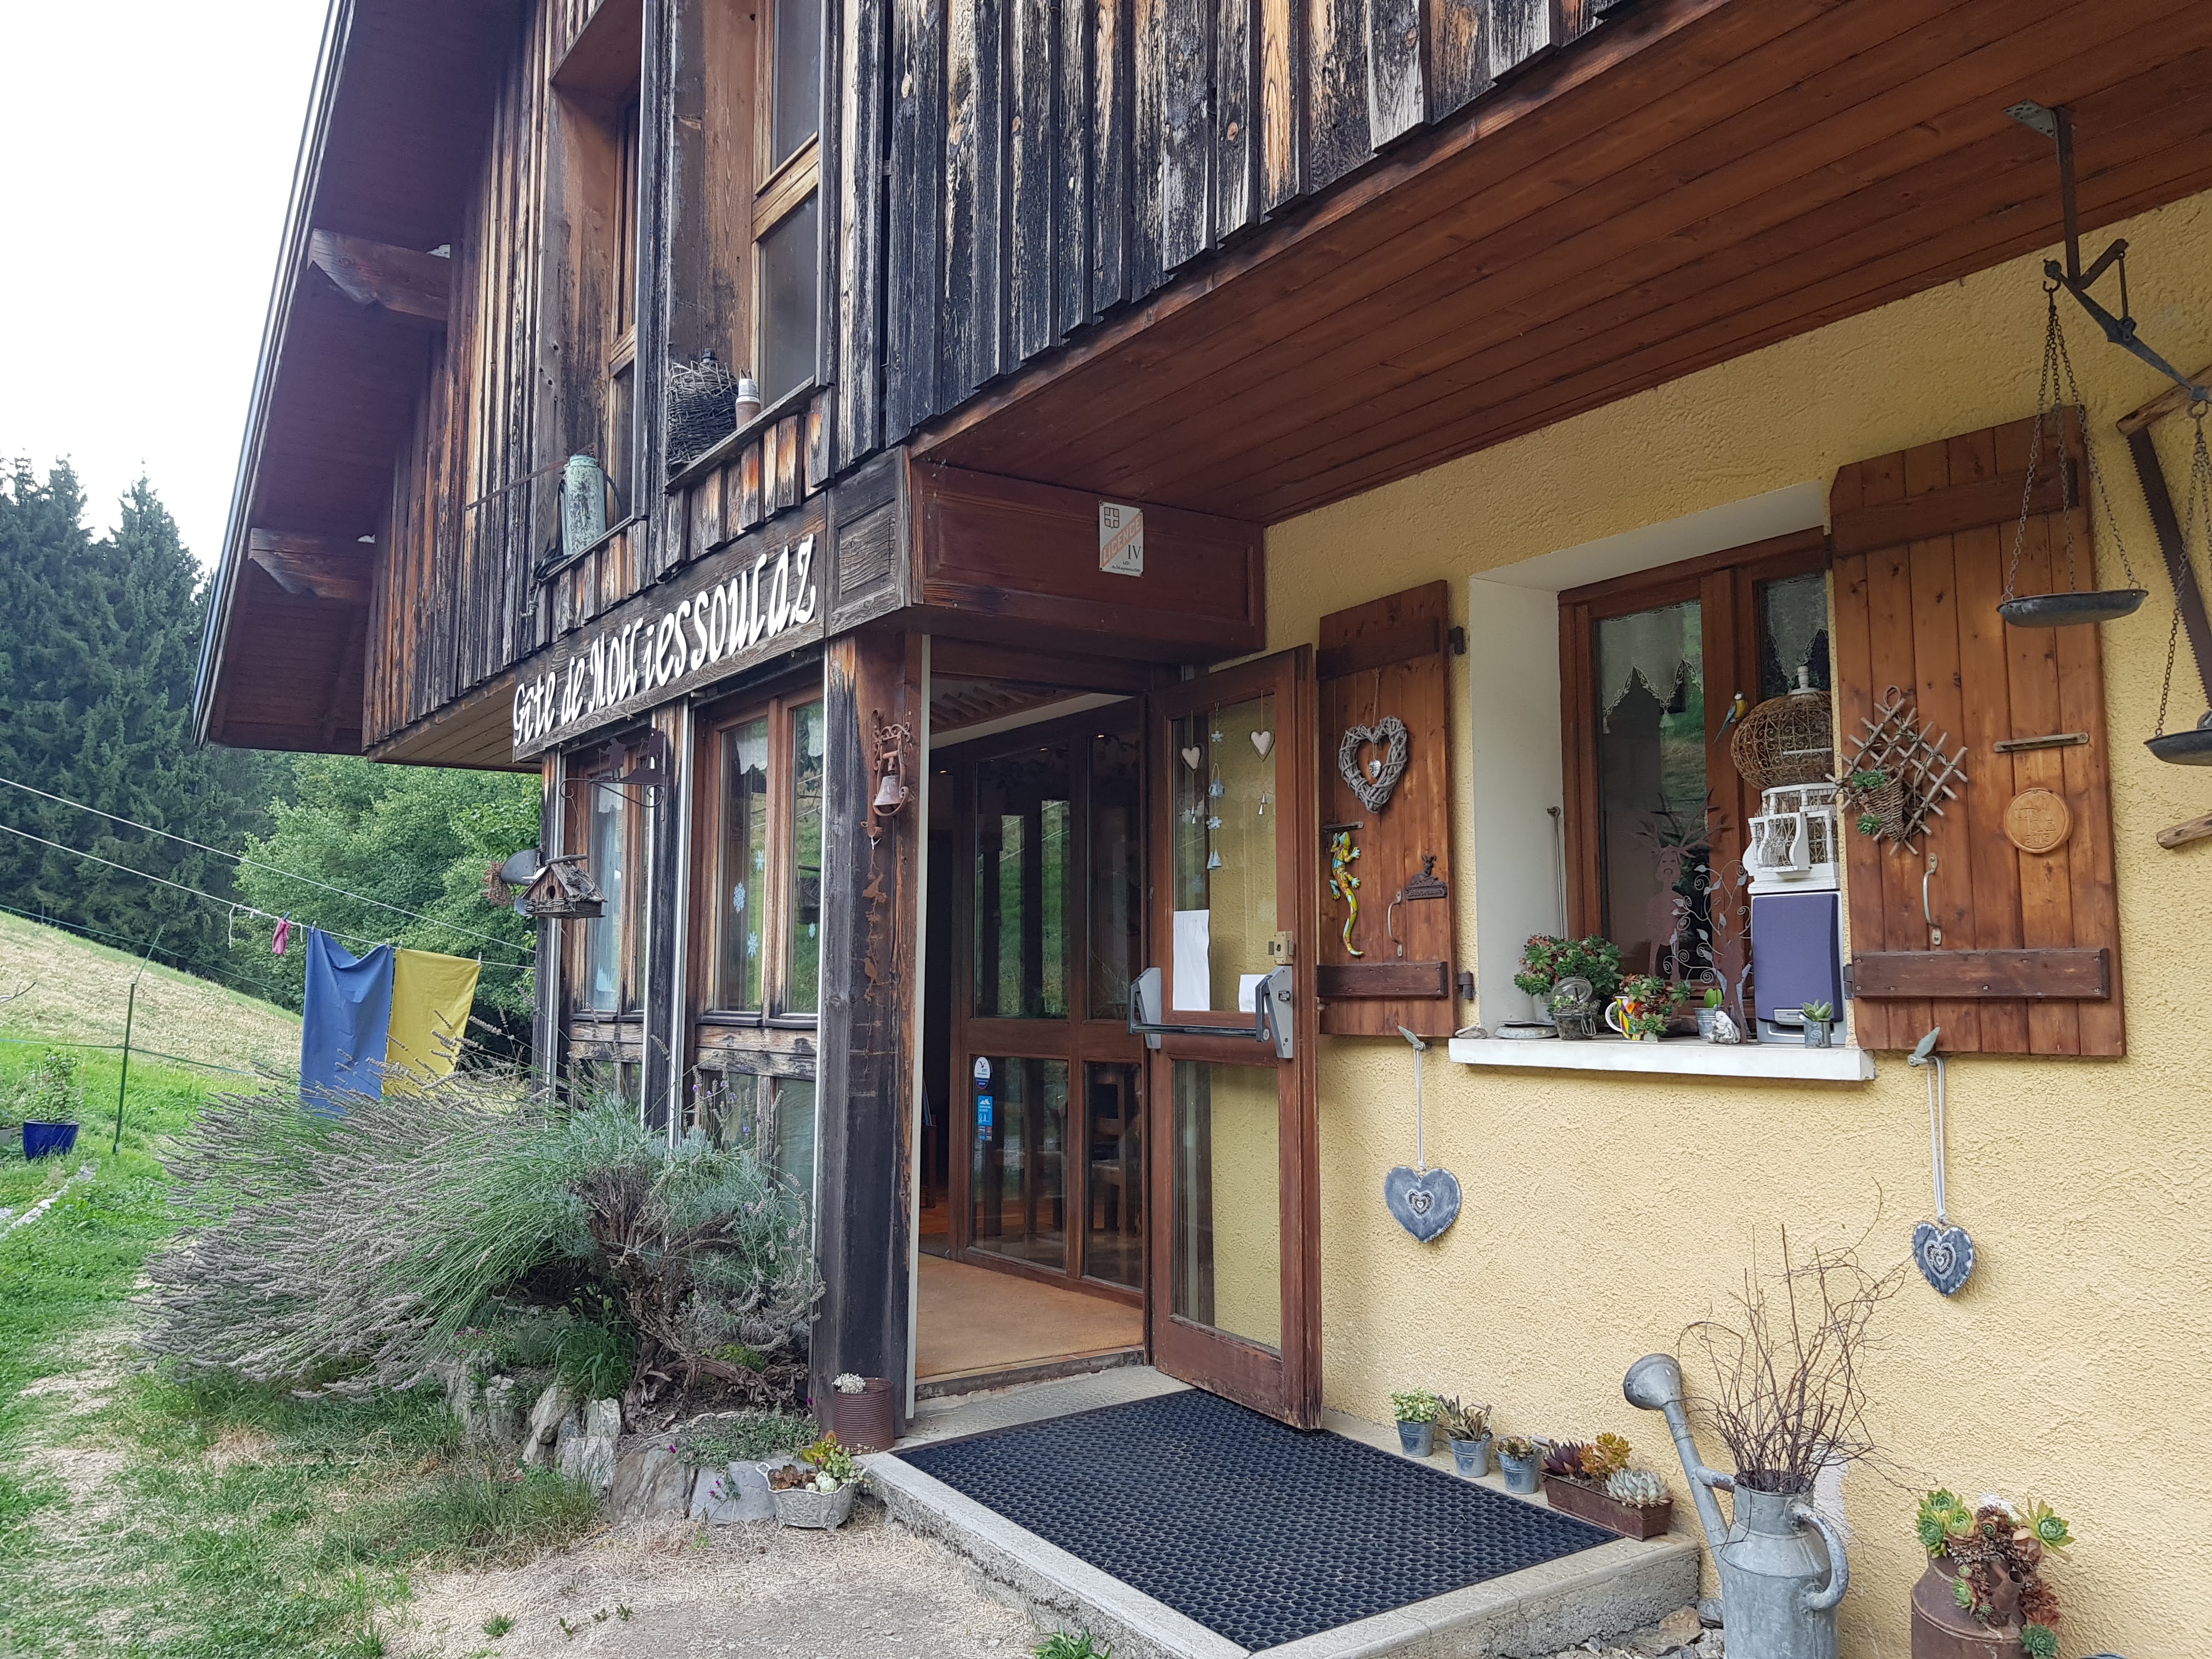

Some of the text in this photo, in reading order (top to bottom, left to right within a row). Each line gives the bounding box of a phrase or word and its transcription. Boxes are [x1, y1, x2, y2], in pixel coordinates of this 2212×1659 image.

[1103, 516, 1141, 562] LICENCE
[1128, 545, 1141, 560] IV
[513, 533, 817, 747] Gîte de Molliessoulaz
